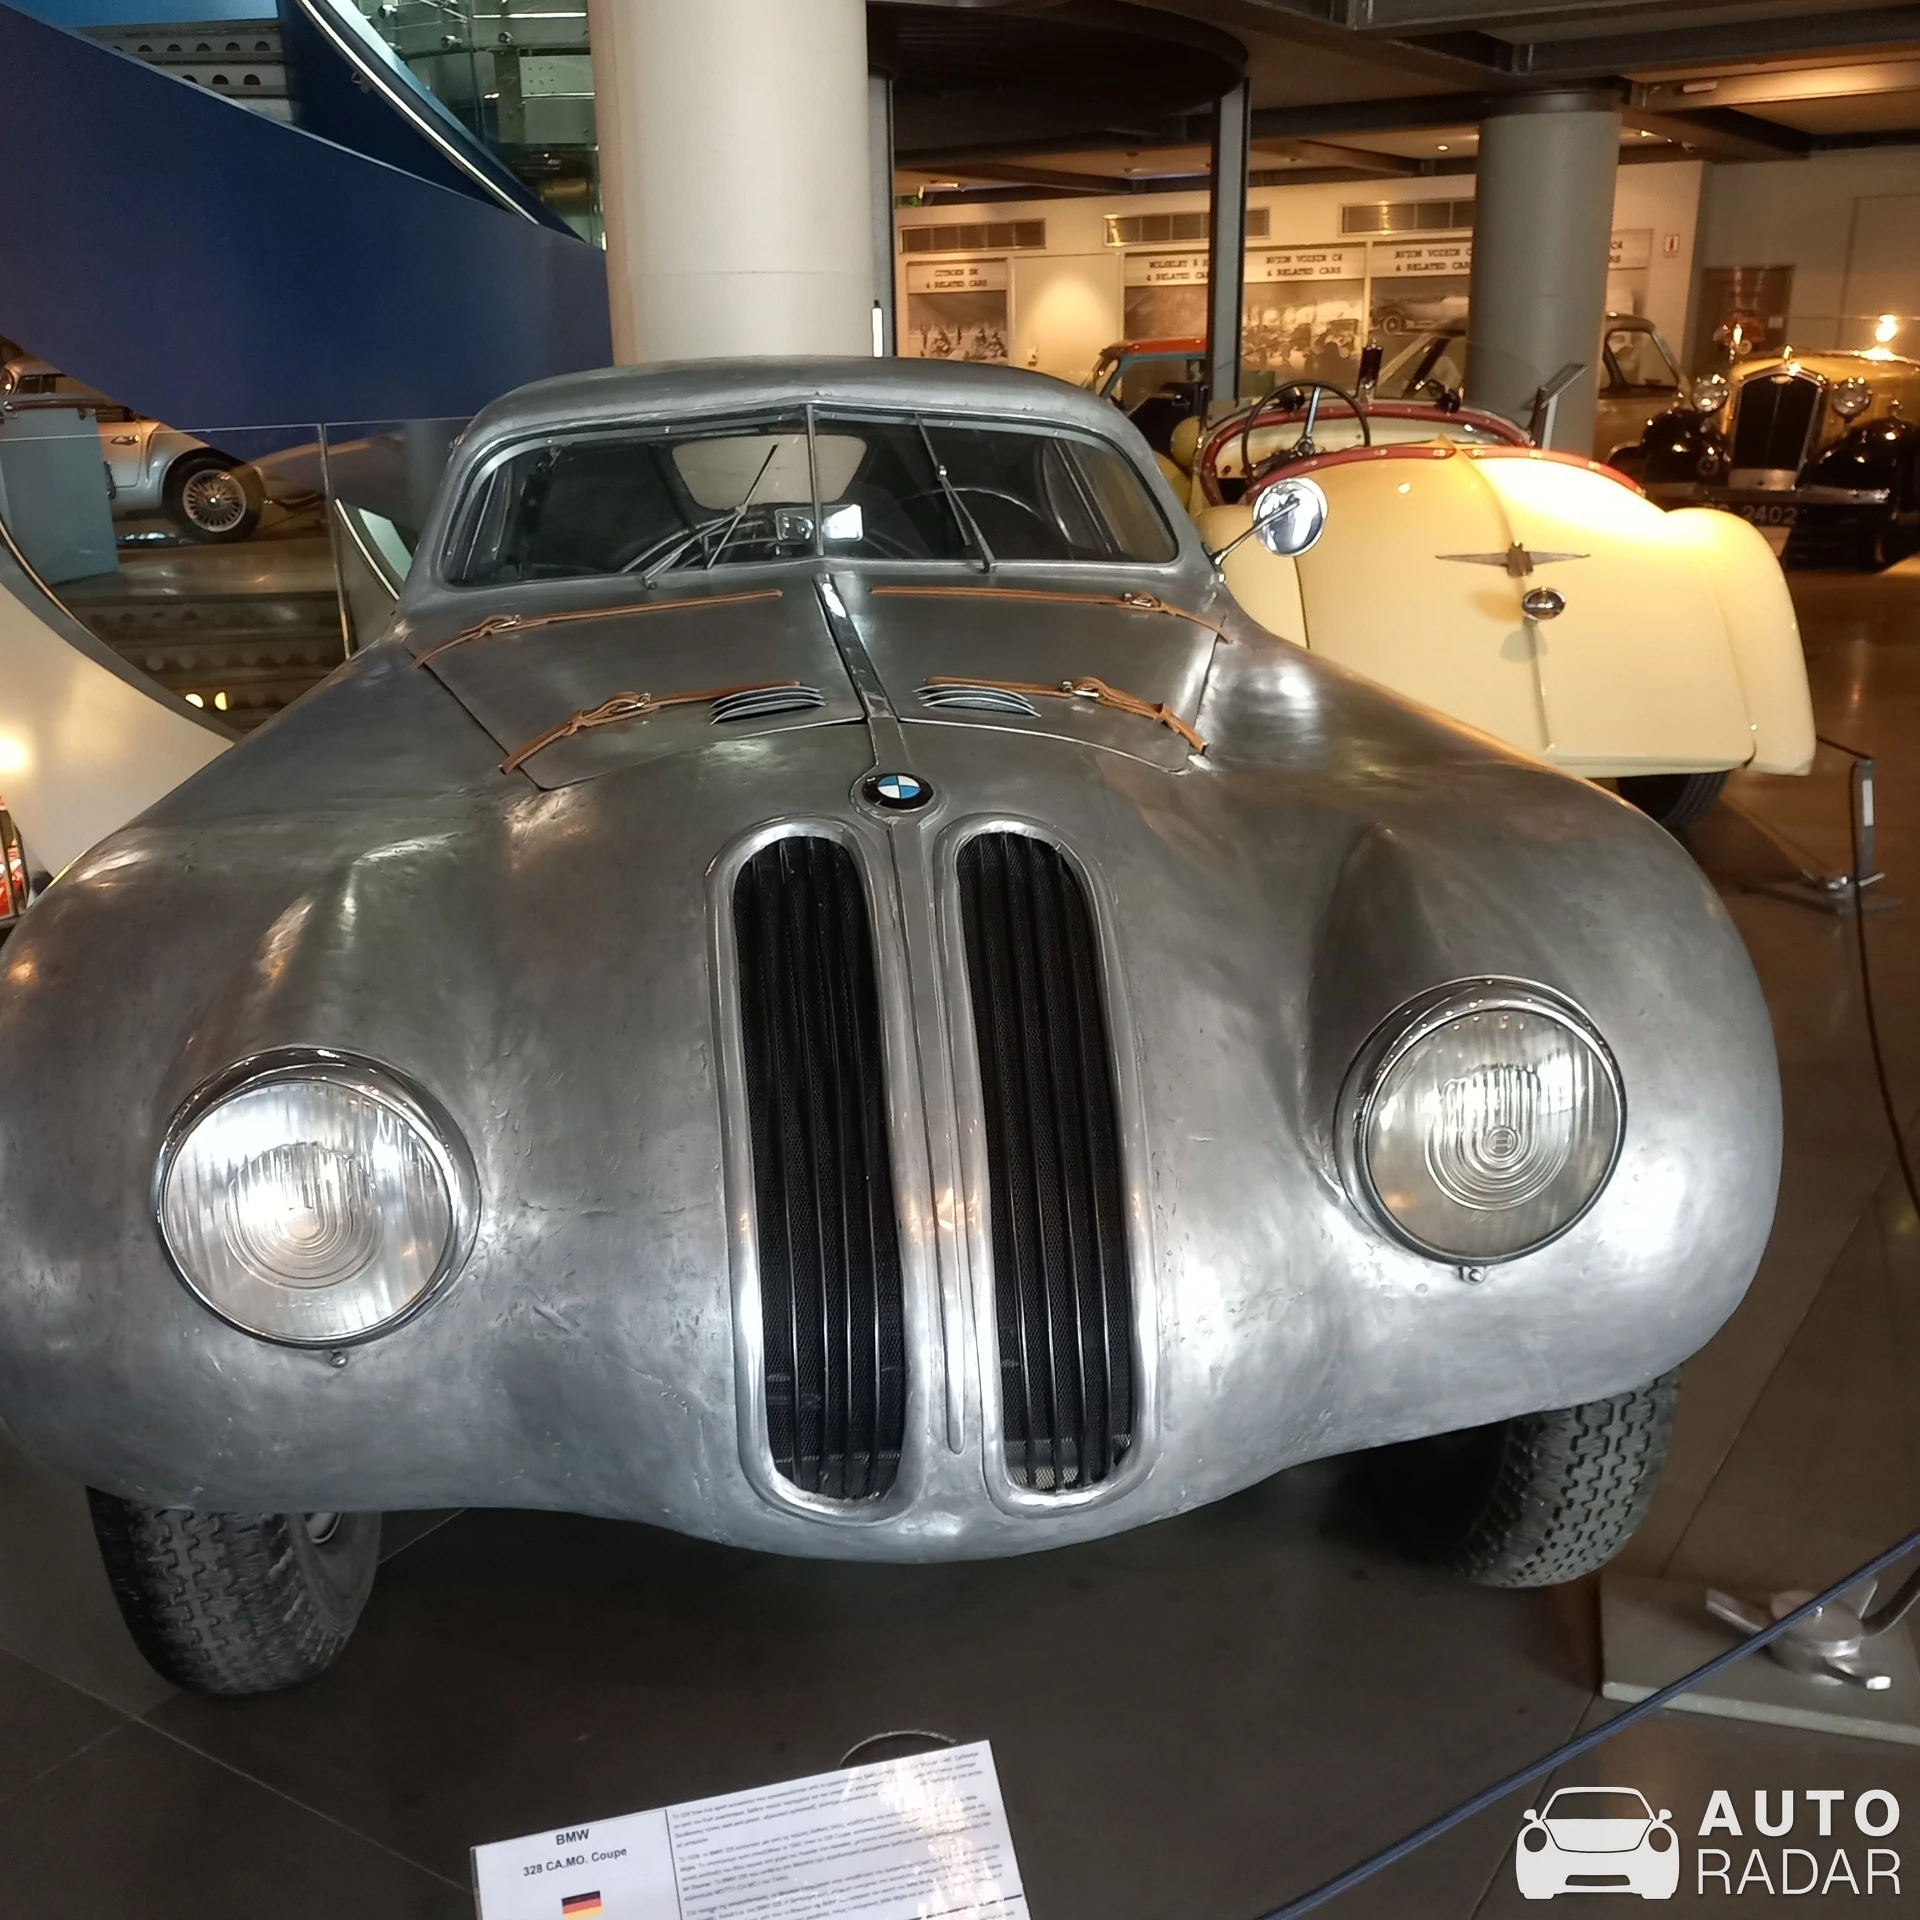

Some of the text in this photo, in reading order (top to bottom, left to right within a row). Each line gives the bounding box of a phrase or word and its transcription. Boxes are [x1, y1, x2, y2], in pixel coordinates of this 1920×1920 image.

[1276, 268, 1314, 276] RELATED
[1319, 266, 1342, 274] CARS
[1406, 262, 1447, 271] RELATED
[1155, 272, 1190, 280] RELATED
[1195, 271, 1209, 279] CA
[934, 280, 965, 288] RELATED
[555, 1828, 590, 1846] BMW
[523, 1848, 628, 1877] 328 CA.MO. Coupe
